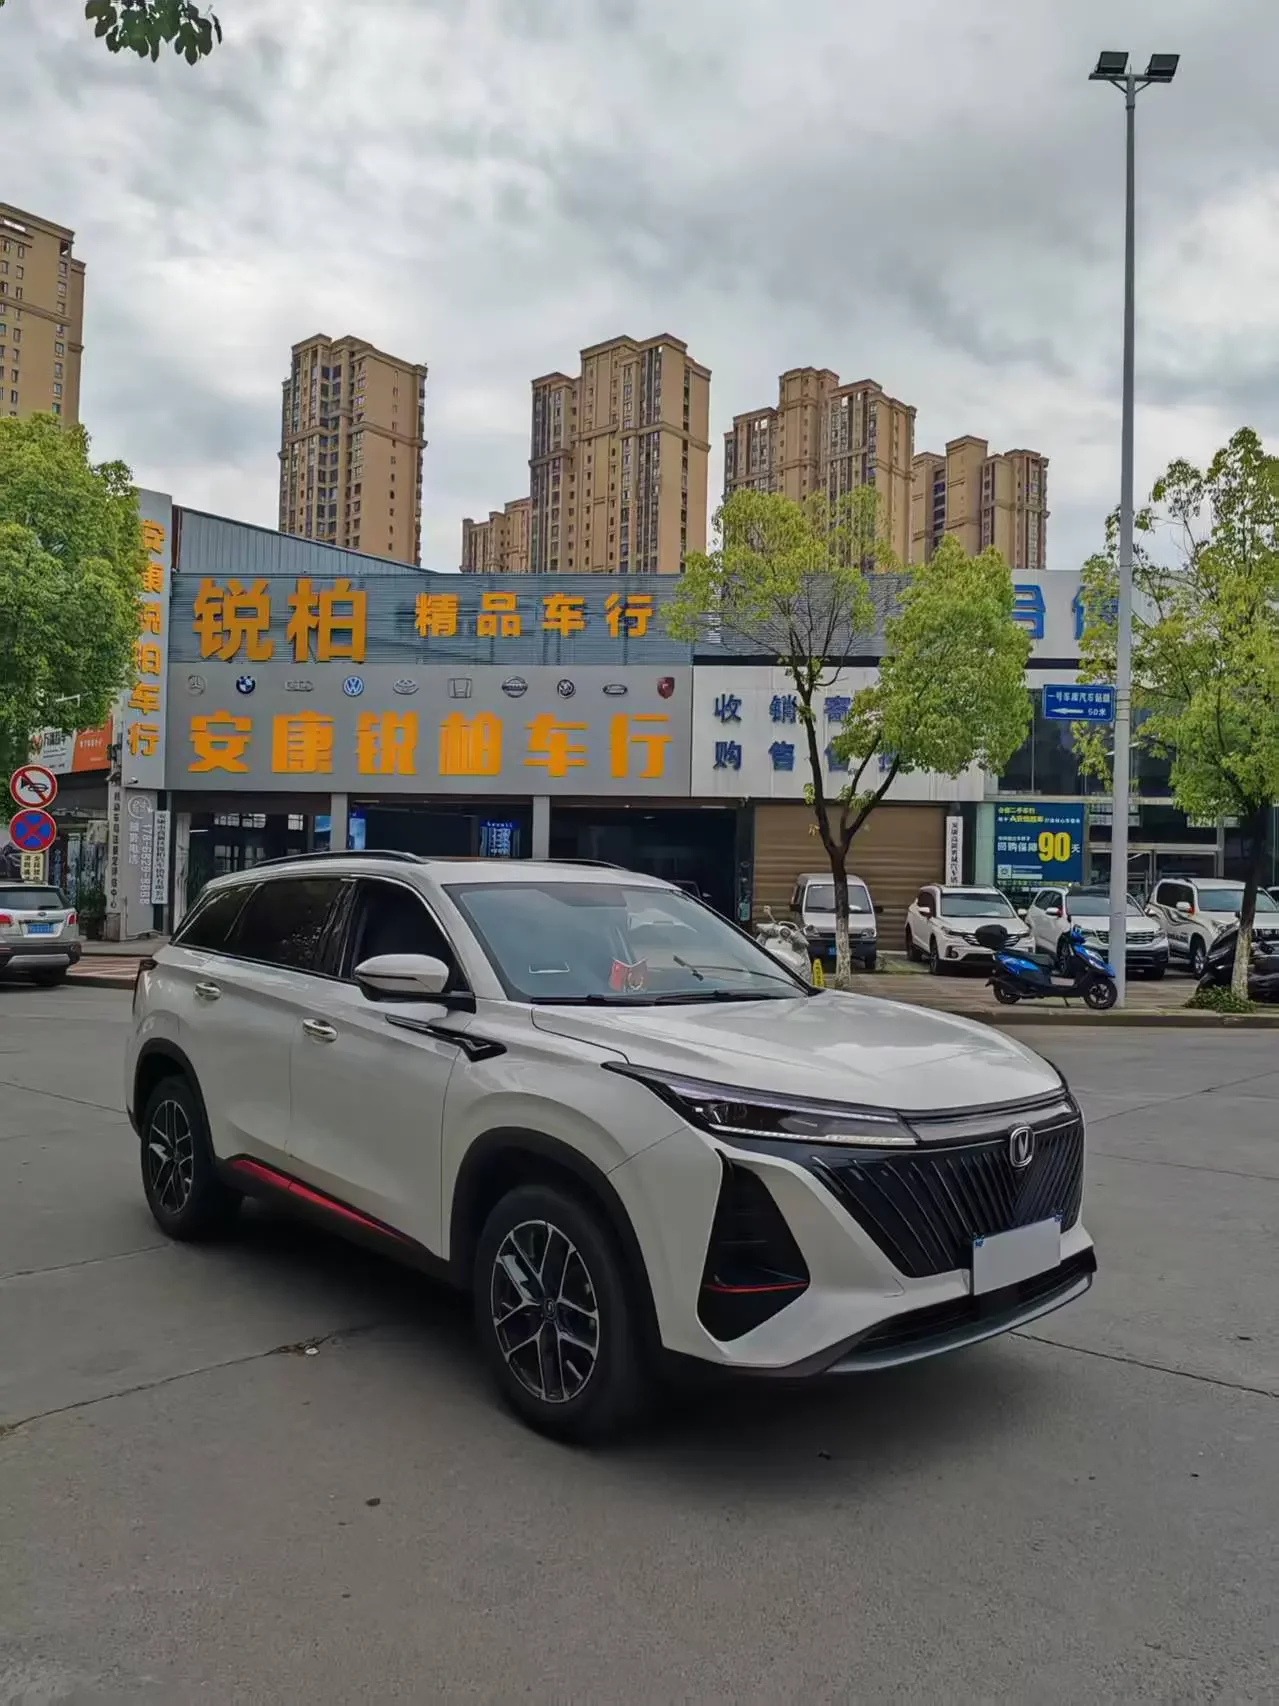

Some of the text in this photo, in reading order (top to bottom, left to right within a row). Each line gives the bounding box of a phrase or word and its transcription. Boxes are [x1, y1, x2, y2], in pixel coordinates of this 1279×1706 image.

[193, 578, 653, 662] 锐柏 精品车行
[189, 712, 671, 778] 安康锐柏车行
